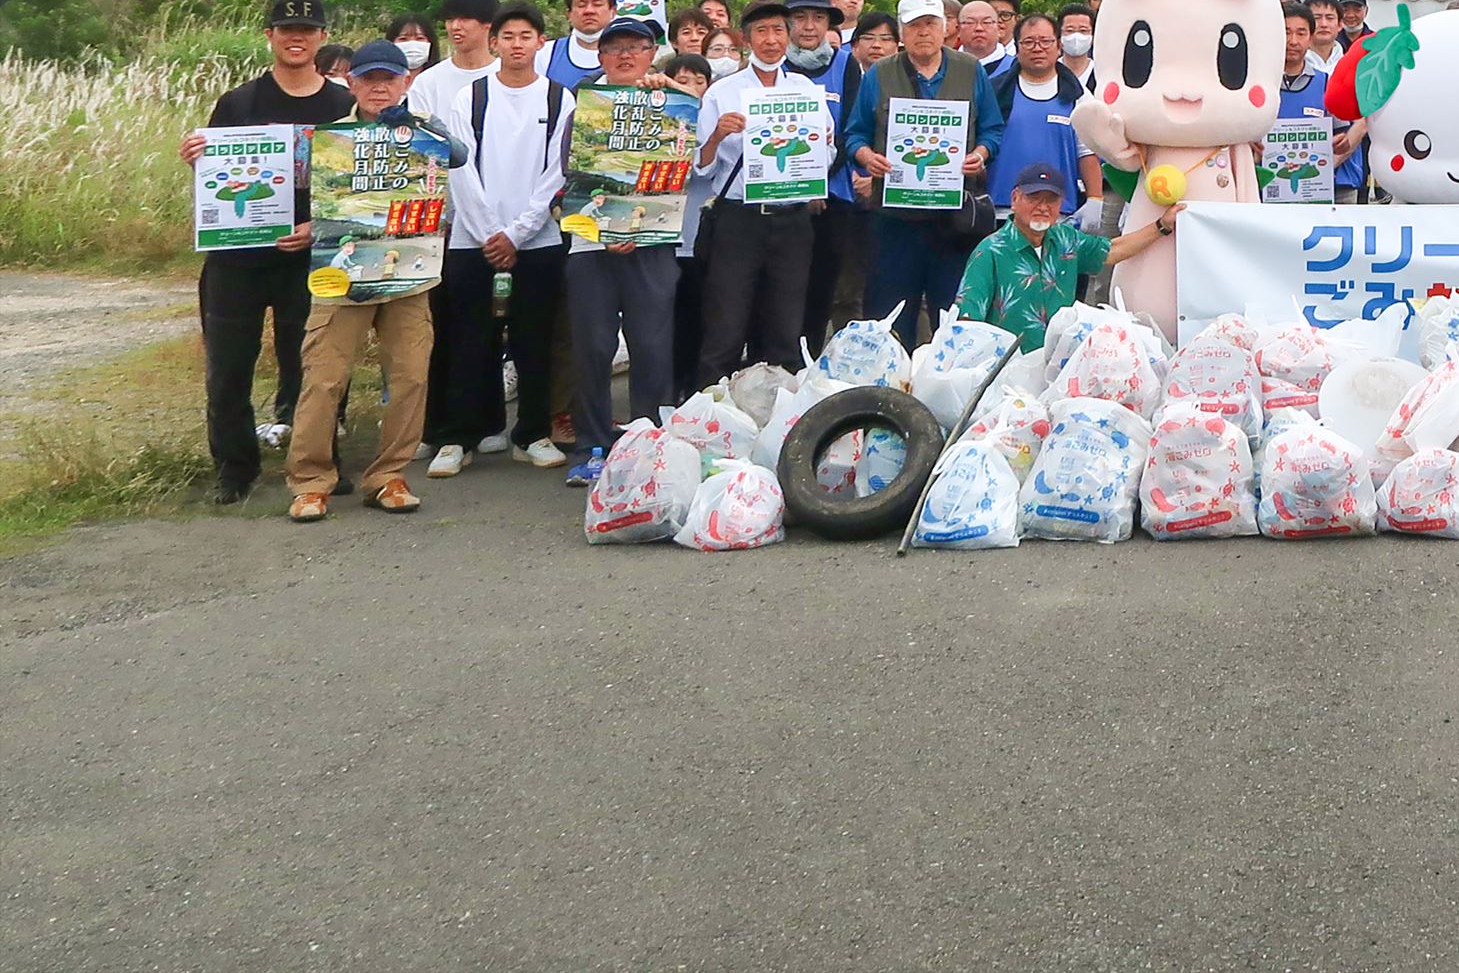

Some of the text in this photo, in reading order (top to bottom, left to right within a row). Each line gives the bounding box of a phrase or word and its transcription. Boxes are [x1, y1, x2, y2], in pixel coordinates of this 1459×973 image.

[204, 142, 286, 156] ボランティア
[608, 90, 629, 151] 強化月間
[627, 90, 648, 150] 散乱防止
[896, 114, 961, 126] ボランティア
[352, 127, 371, 191] 強化月間
[372, 127, 390, 190] 散乱防止
[1150, 176, 1171, 198] R
